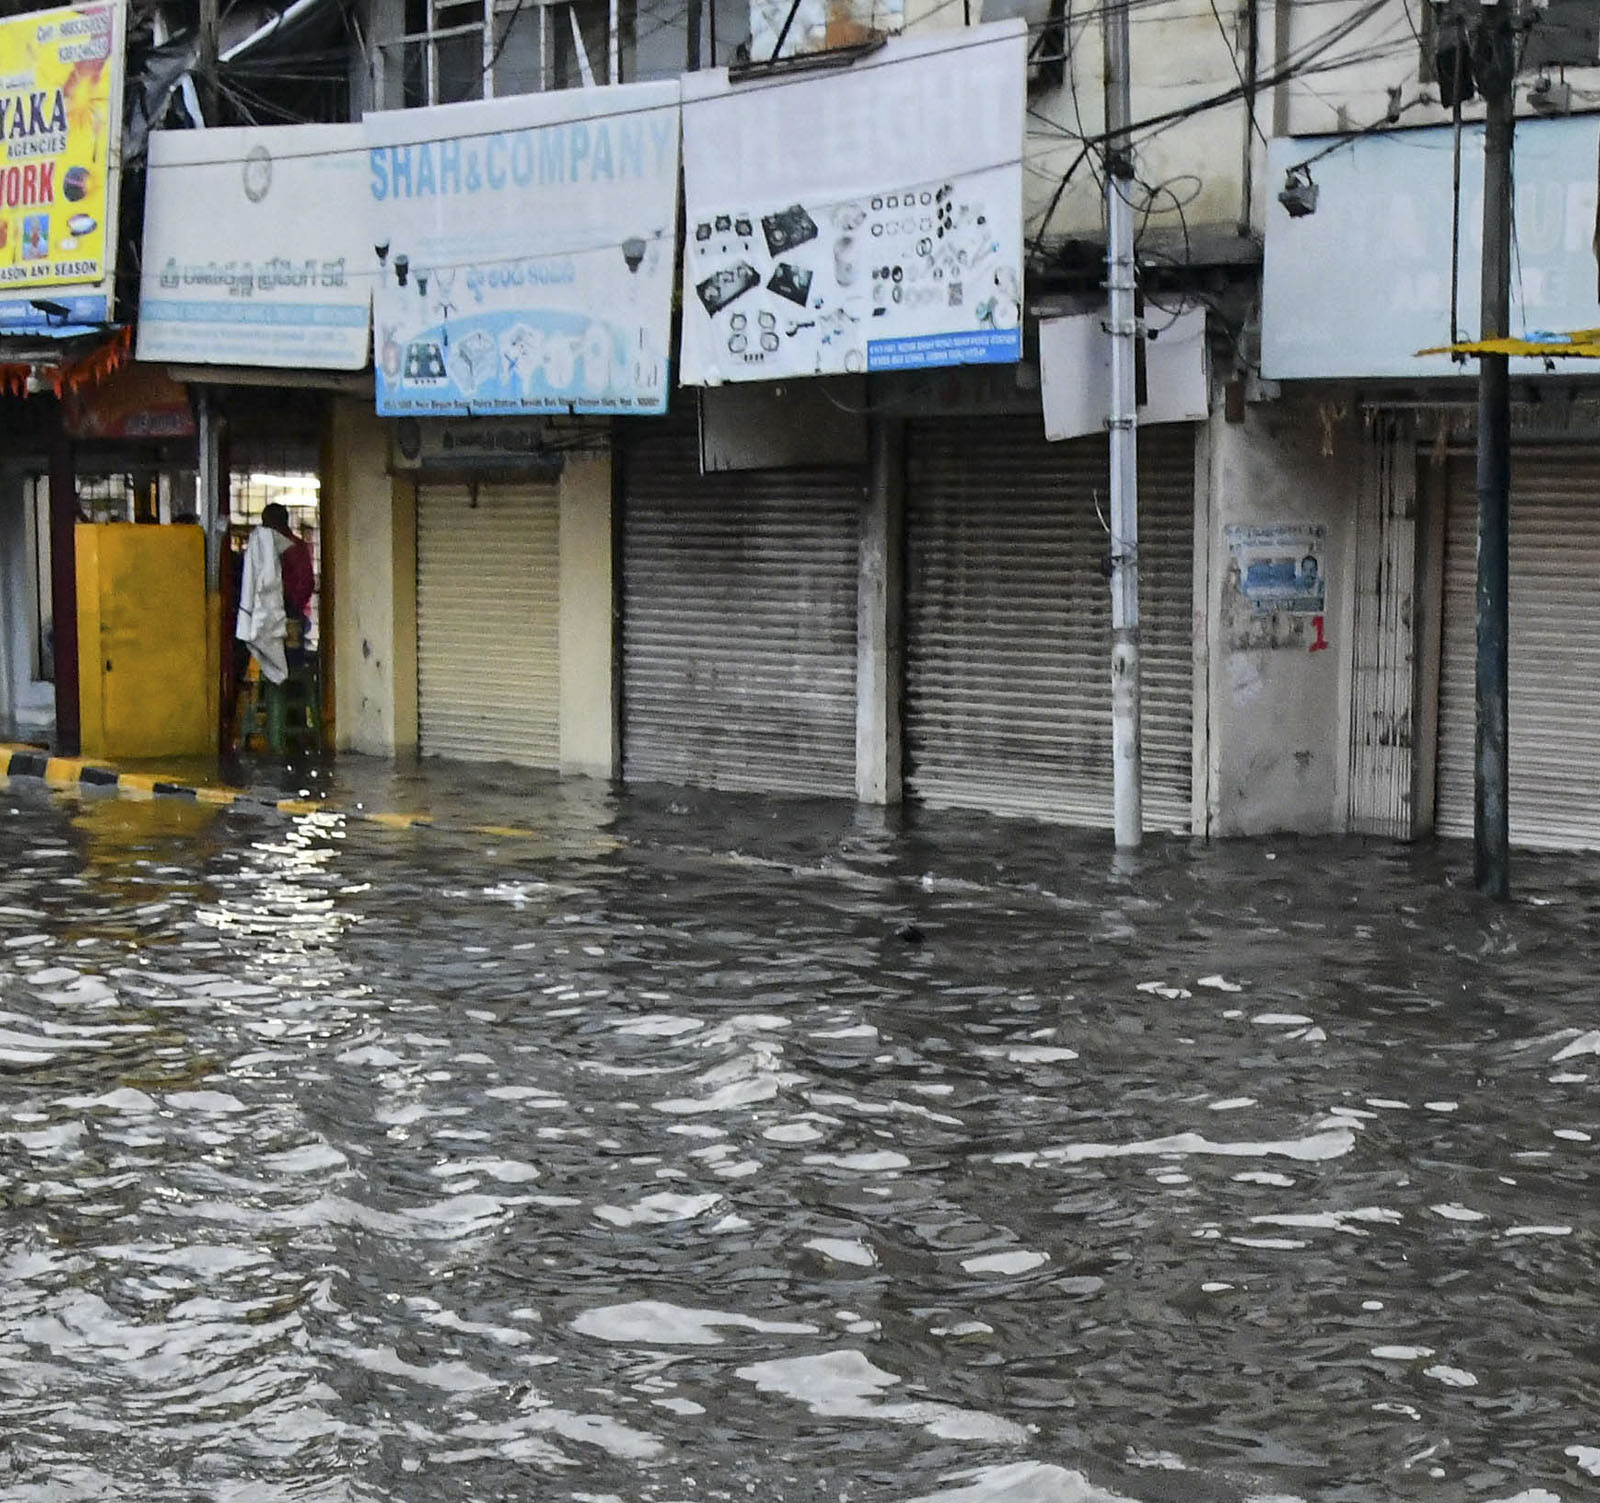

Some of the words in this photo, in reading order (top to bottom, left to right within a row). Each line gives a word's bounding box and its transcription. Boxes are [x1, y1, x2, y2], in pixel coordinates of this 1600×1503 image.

[7, 135, 67, 159] AGENCIES
[31, 264, 50, 277] ANY
[54, 260, 98, 276] SEASON
